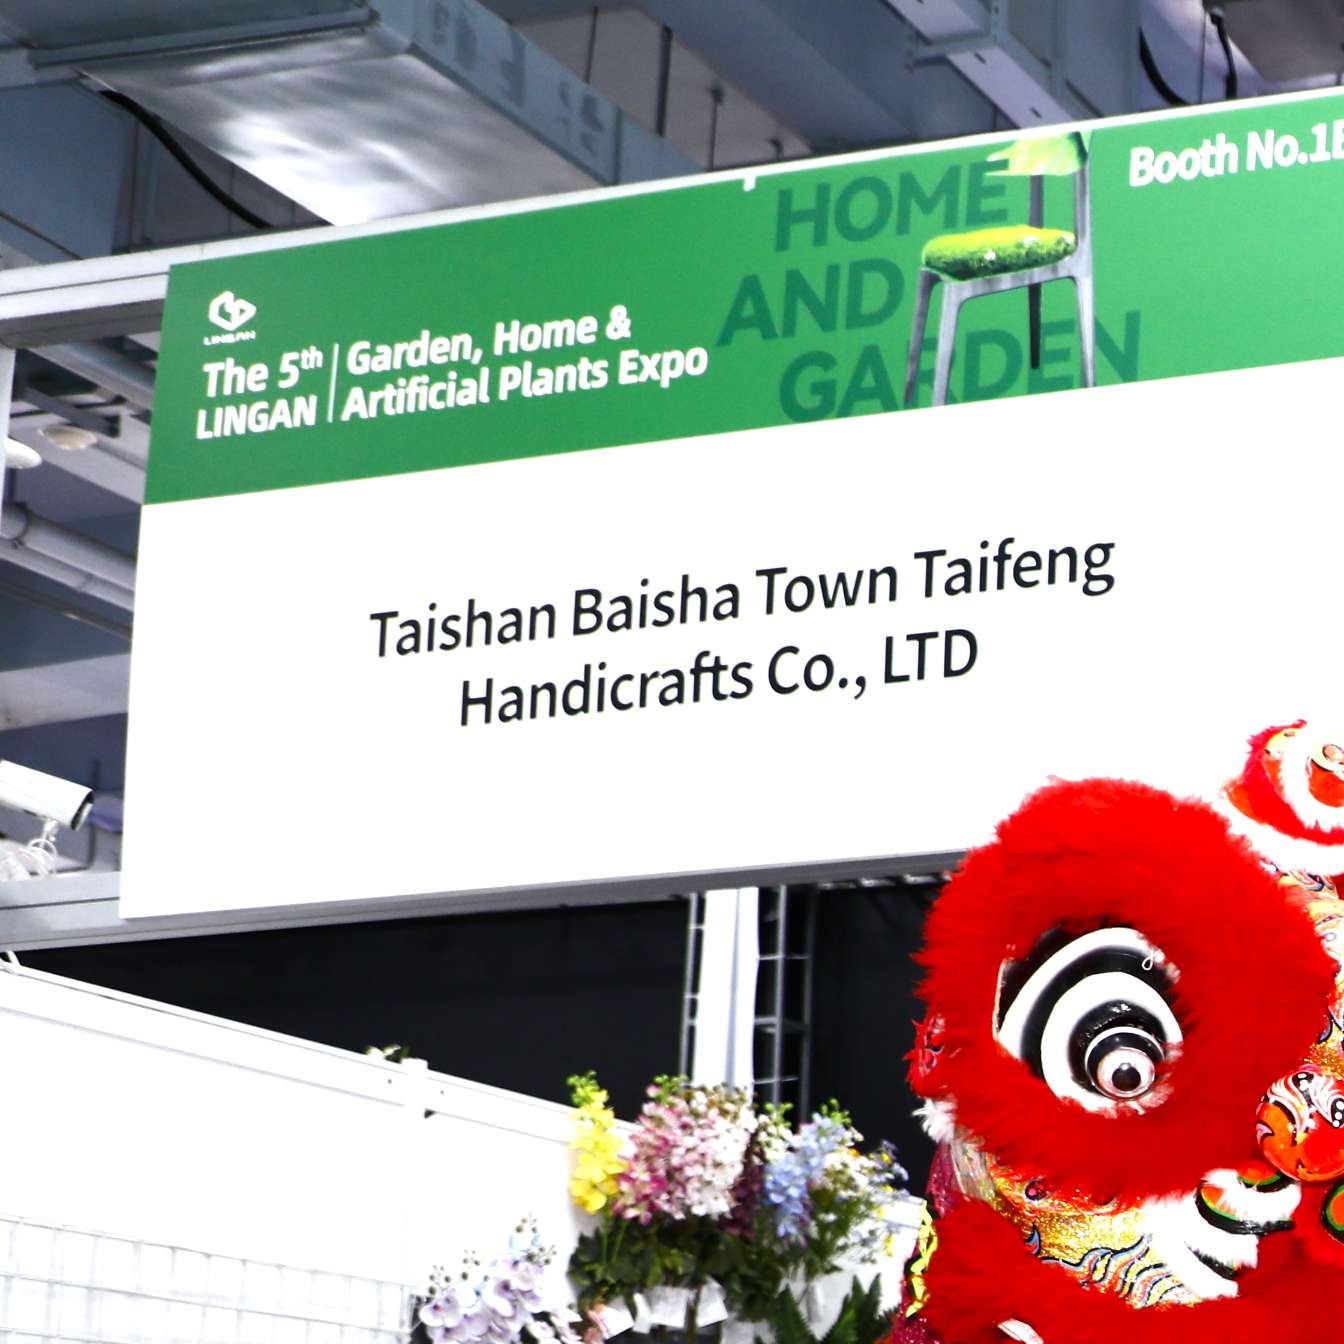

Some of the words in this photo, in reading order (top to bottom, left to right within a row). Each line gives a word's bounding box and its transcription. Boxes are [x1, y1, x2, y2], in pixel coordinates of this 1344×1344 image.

[1129, 132, 1238, 187] Booth
[774, 160, 1009, 253] HOME
[347, 331, 481, 376] Garden,
[493, 314, 597, 355] Home
[605, 304, 631, 340] &
[716, 258, 904, 348] AND
[203, 358, 268, 398] The
[279, 345, 323, 385] 5th
[340, 367, 490, 422] Artificial
[498, 356, 609, 400] Plants
[617, 347, 708, 388] Expo
[196, 394, 317, 439] LINGAN
[369, 600, 557, 658] Taishan
[571, 575, 740, 636] Baisha
[756, 564, 898, 616] Town
[913, 536, 1116, 598] Taifeng
[460, 651, 753, 727] Handicrafts
[767, 645, 867, 699] Co.,
[883, 627, 979, 685] LTD
